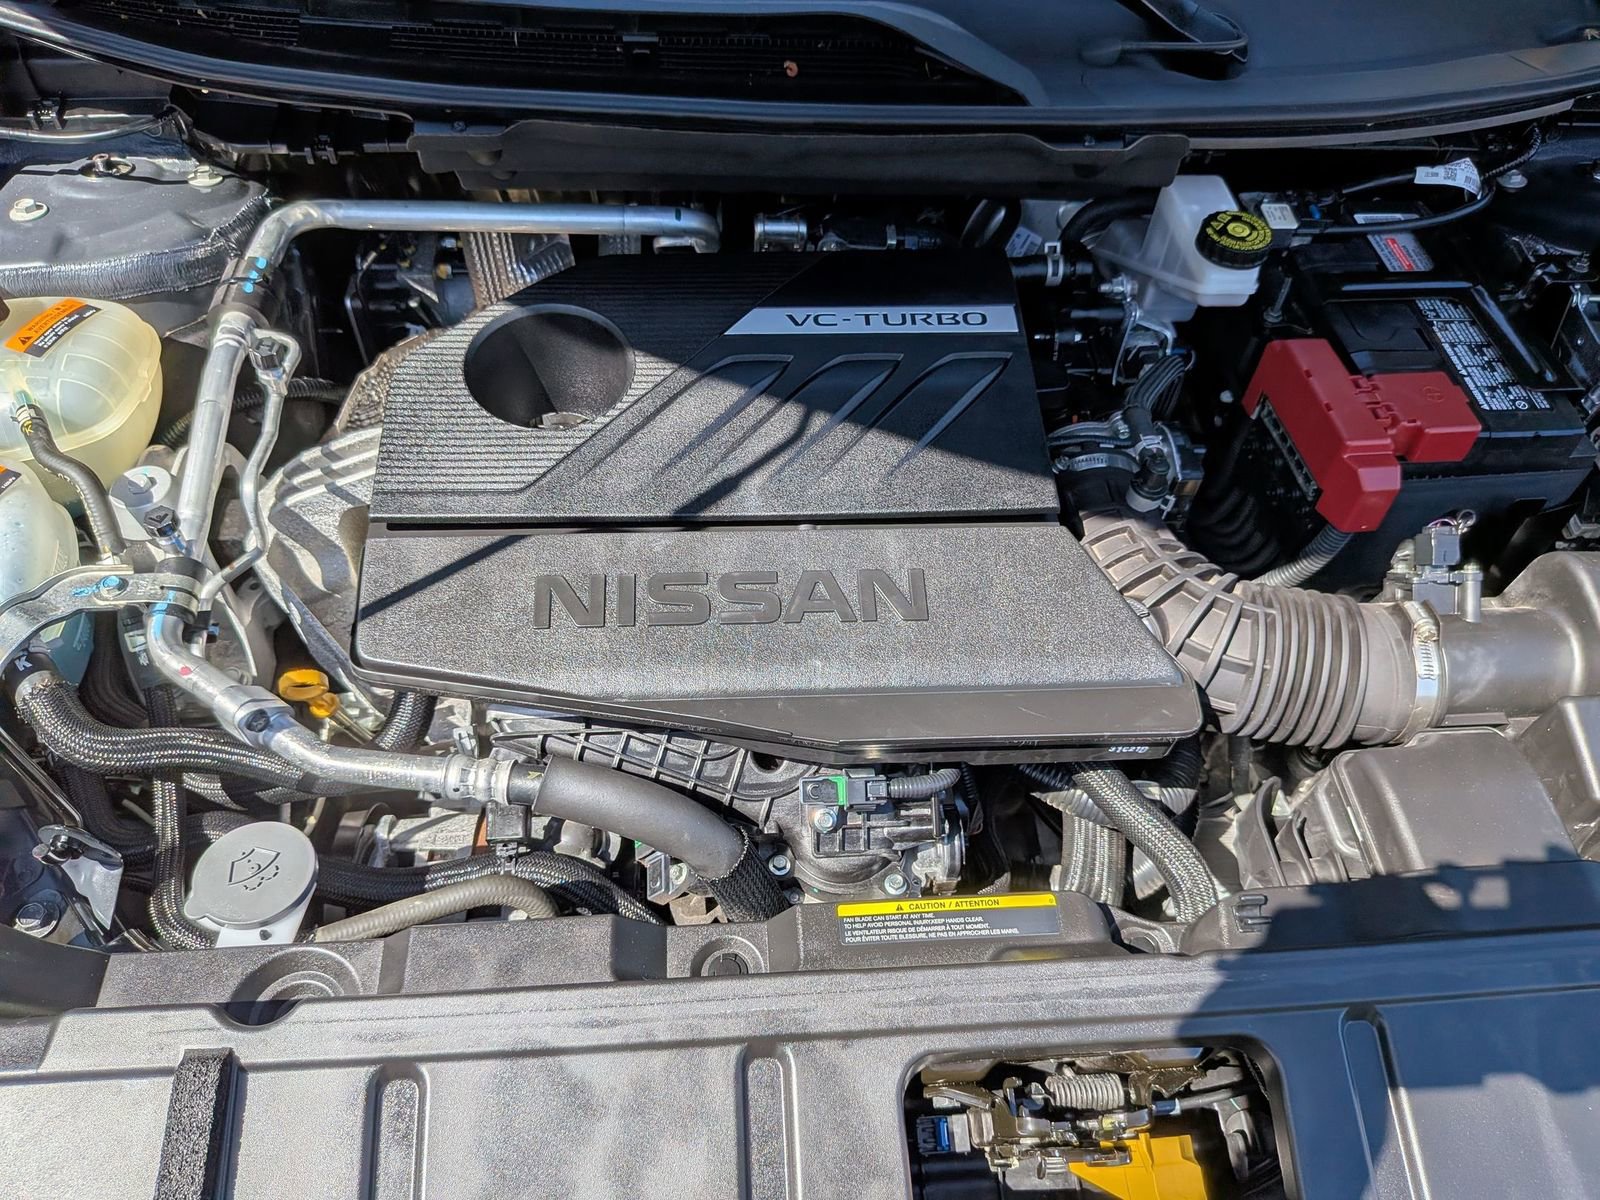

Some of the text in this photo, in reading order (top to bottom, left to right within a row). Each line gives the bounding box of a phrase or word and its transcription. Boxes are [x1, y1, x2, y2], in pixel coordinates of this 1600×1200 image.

[786, 312, 987, 327] VC-TURBO
[533, 569, 929, 629] NISSAN
[14, 655, 33, 672] K
[908, 902, 946, 910] CAUTION
[955, 899, 1000, 907] ATTENTION
